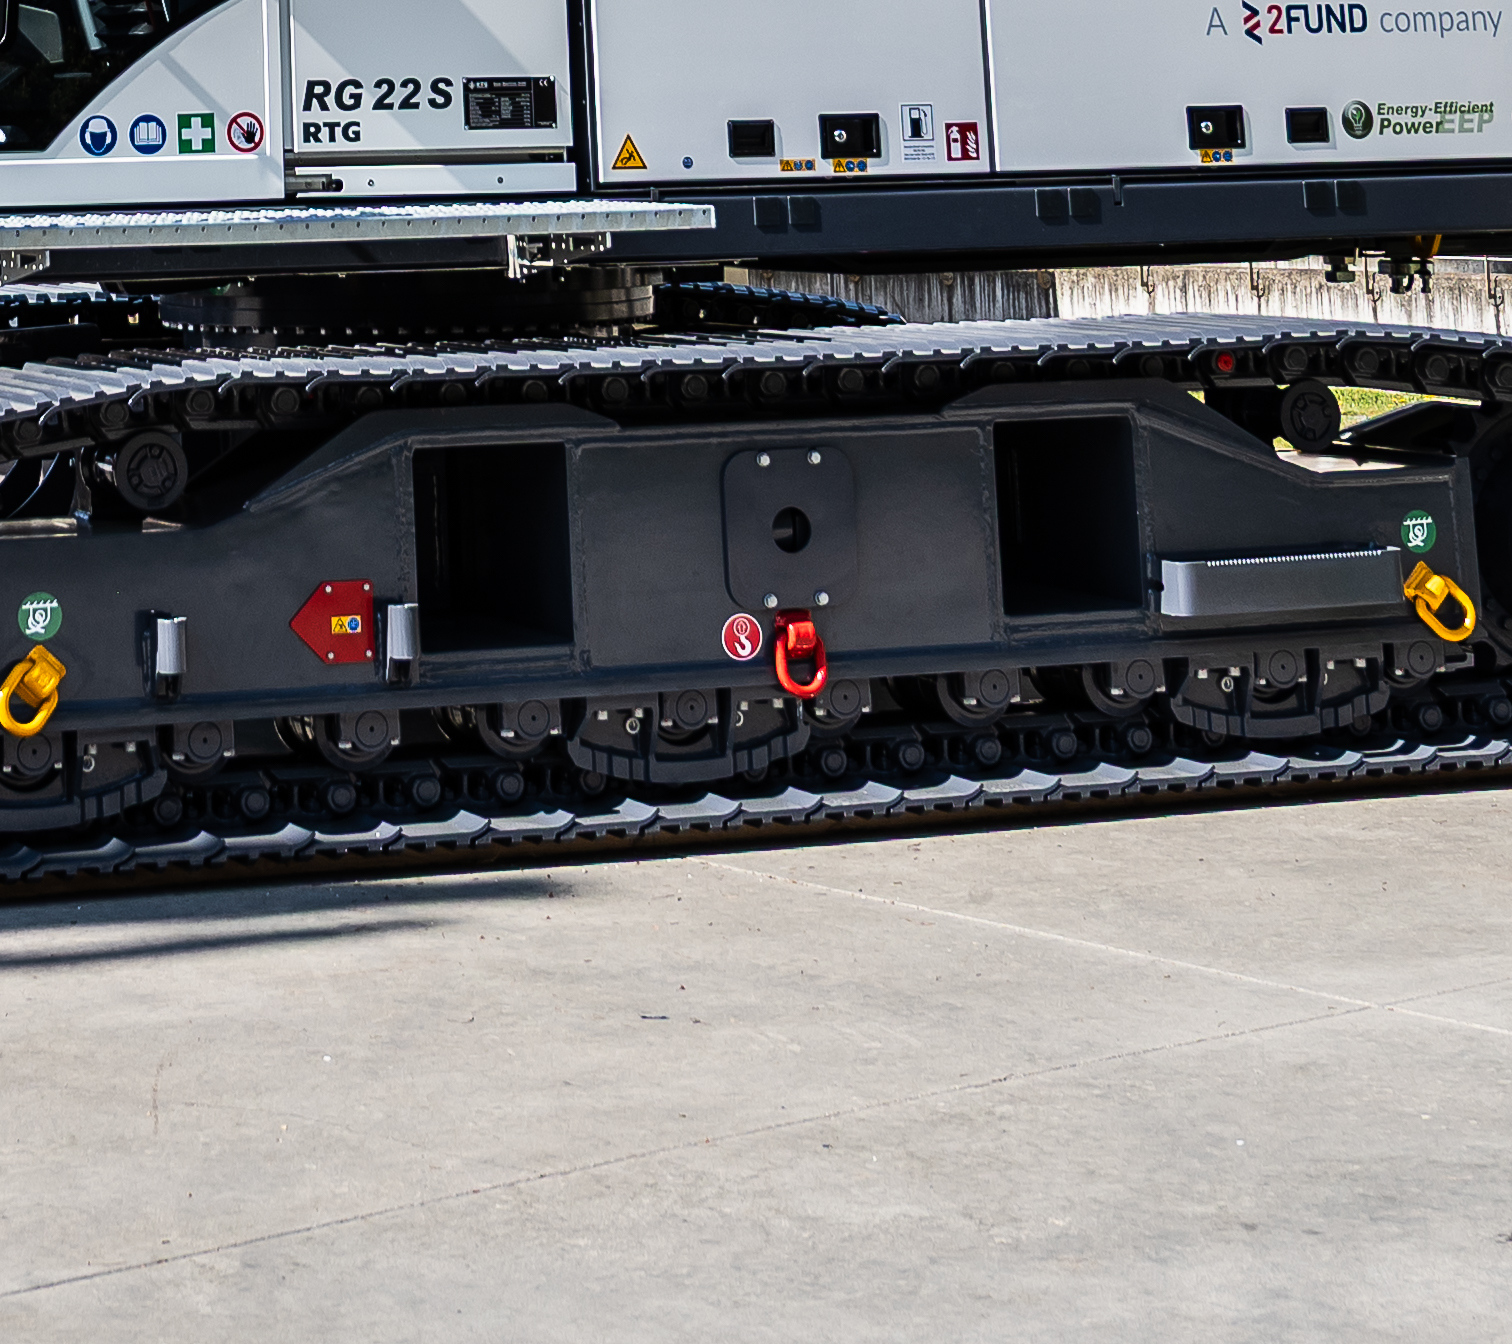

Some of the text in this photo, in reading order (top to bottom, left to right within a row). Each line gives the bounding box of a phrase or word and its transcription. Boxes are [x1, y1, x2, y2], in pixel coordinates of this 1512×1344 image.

[1206, 3, 1503, 38] A 2FUND company
[1377, 101, 1494, 118] Energy-Efficient
[302, 120, 362, 144] RTG
[1379, 112, 1495, 135] Power EEP
